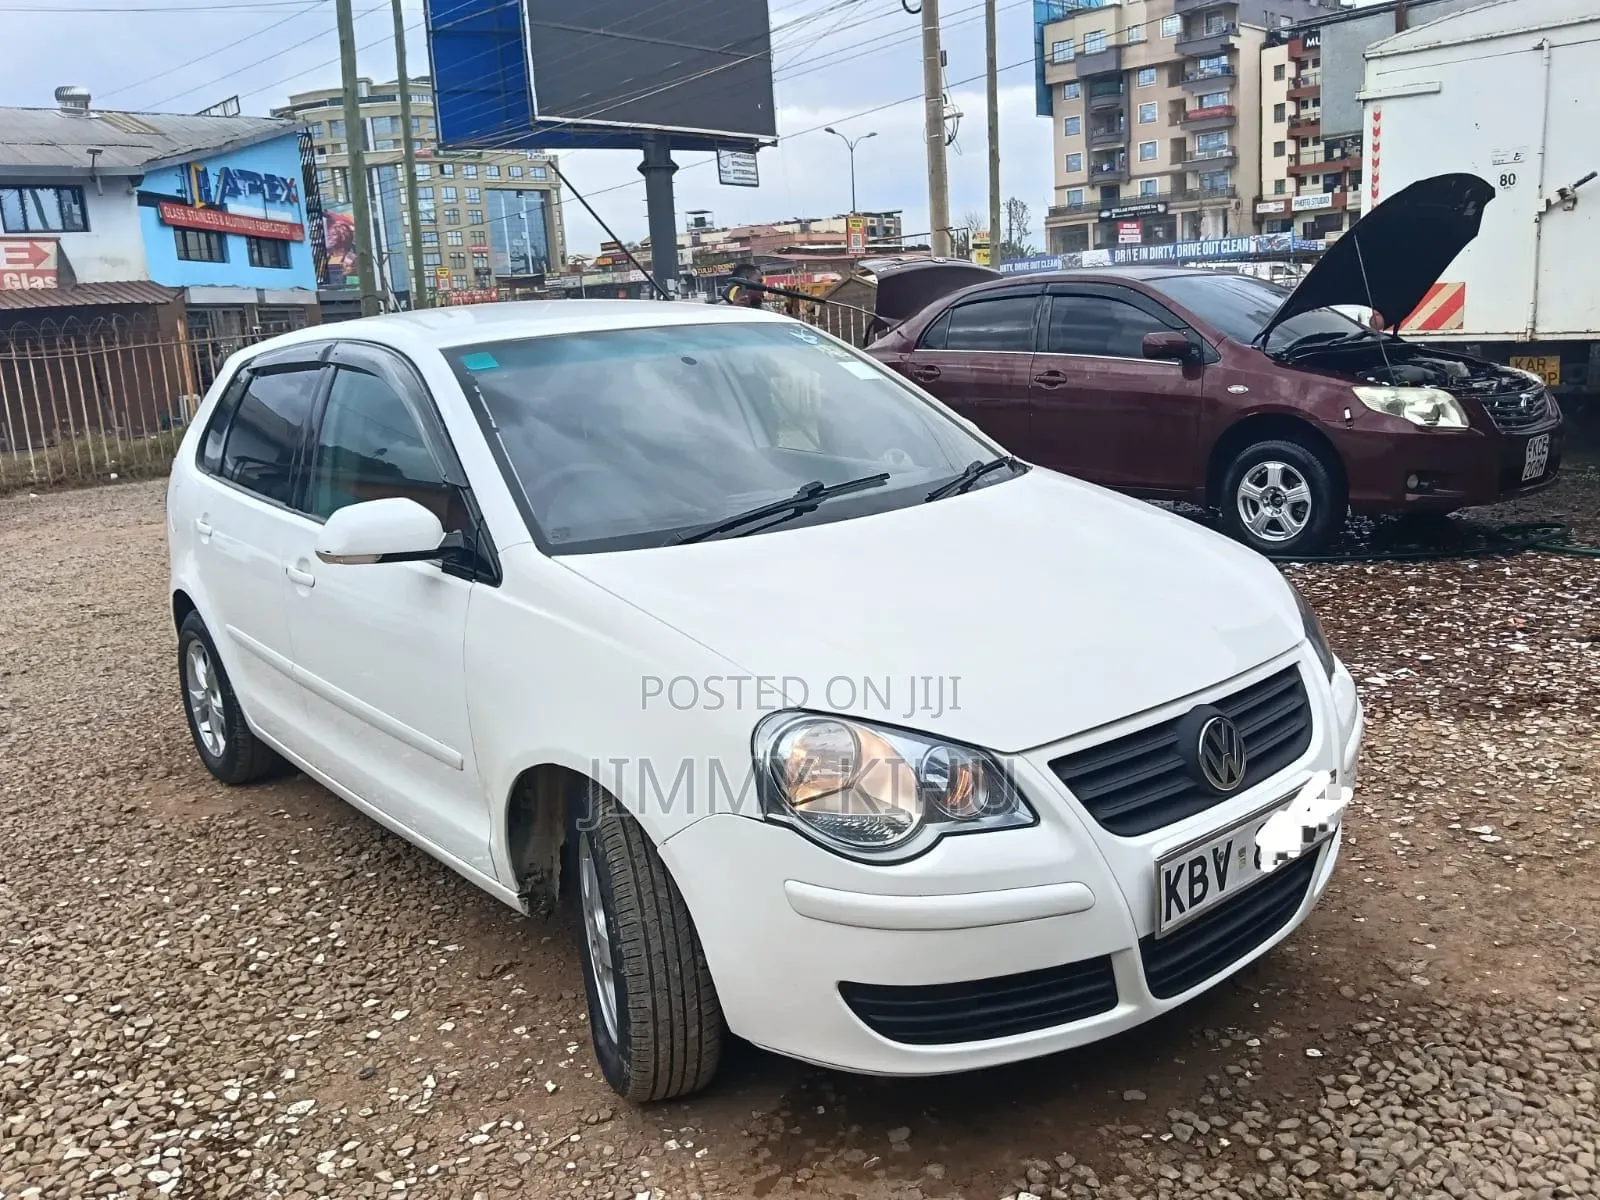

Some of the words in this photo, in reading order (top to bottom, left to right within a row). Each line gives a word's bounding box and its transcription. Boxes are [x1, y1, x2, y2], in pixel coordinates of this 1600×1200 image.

[1500, 173, 1516, 187] 80
[1294, 198, 1310, 207] PHOTO
[1311, 196, 1330, 206] STUDIO
[186, 208, 220, 225] STAINLESS
[1114, 248, 1139, 263] DRIVE
[1139, 247, 1149, 261] IN
[1149, 244, 1176, 260] DIRTY,
[1176, 240, 1202, 258] DRIVE
[1202, 240, 1221, 256] OUT
[1220, 237, 1249, 254] CLEAN
[1014, 261, 1030, 271] DRIVE
[1029, 260, 1041, 270] OUT
[1040, 258, 1059, 269] CLEAN
[3, 272, 57, 290] Glas
[1515, 357, 1547, 371] KAR
[1163, 839, 1234, 923] KBV
